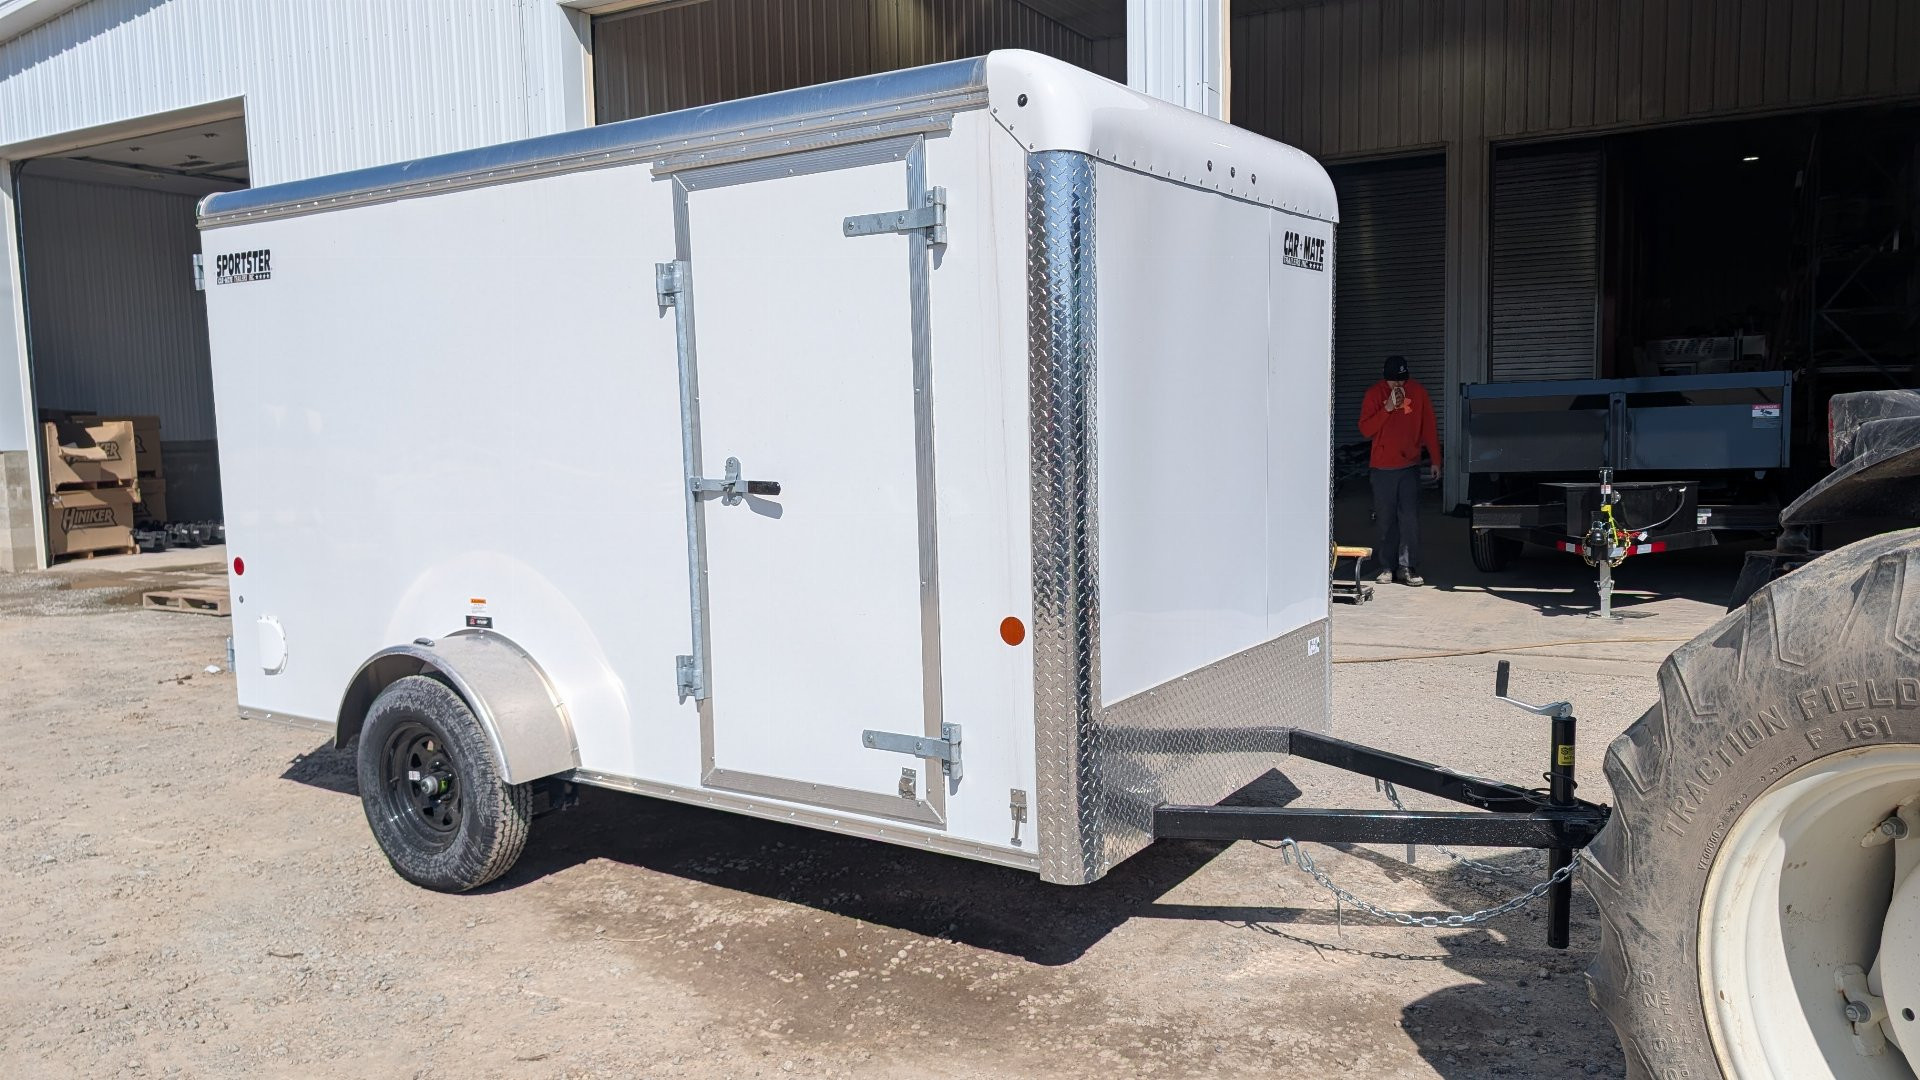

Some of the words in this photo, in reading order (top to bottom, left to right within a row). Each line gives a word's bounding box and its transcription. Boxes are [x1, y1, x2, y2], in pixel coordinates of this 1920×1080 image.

[216, 249, 271, 277] SPORTSTER
[1284, 231, 1300, 258] CAR
[1303, 236, 1325, 263] MATE
[62, 507, 115, 531] HINIKER
[1804, 727, 1823, 750] F
[1840, 715, 1893, 742] 151
[1661, 705, 1789, 838] TRACTION
[1797, 677, 1920, 721] FIELD
